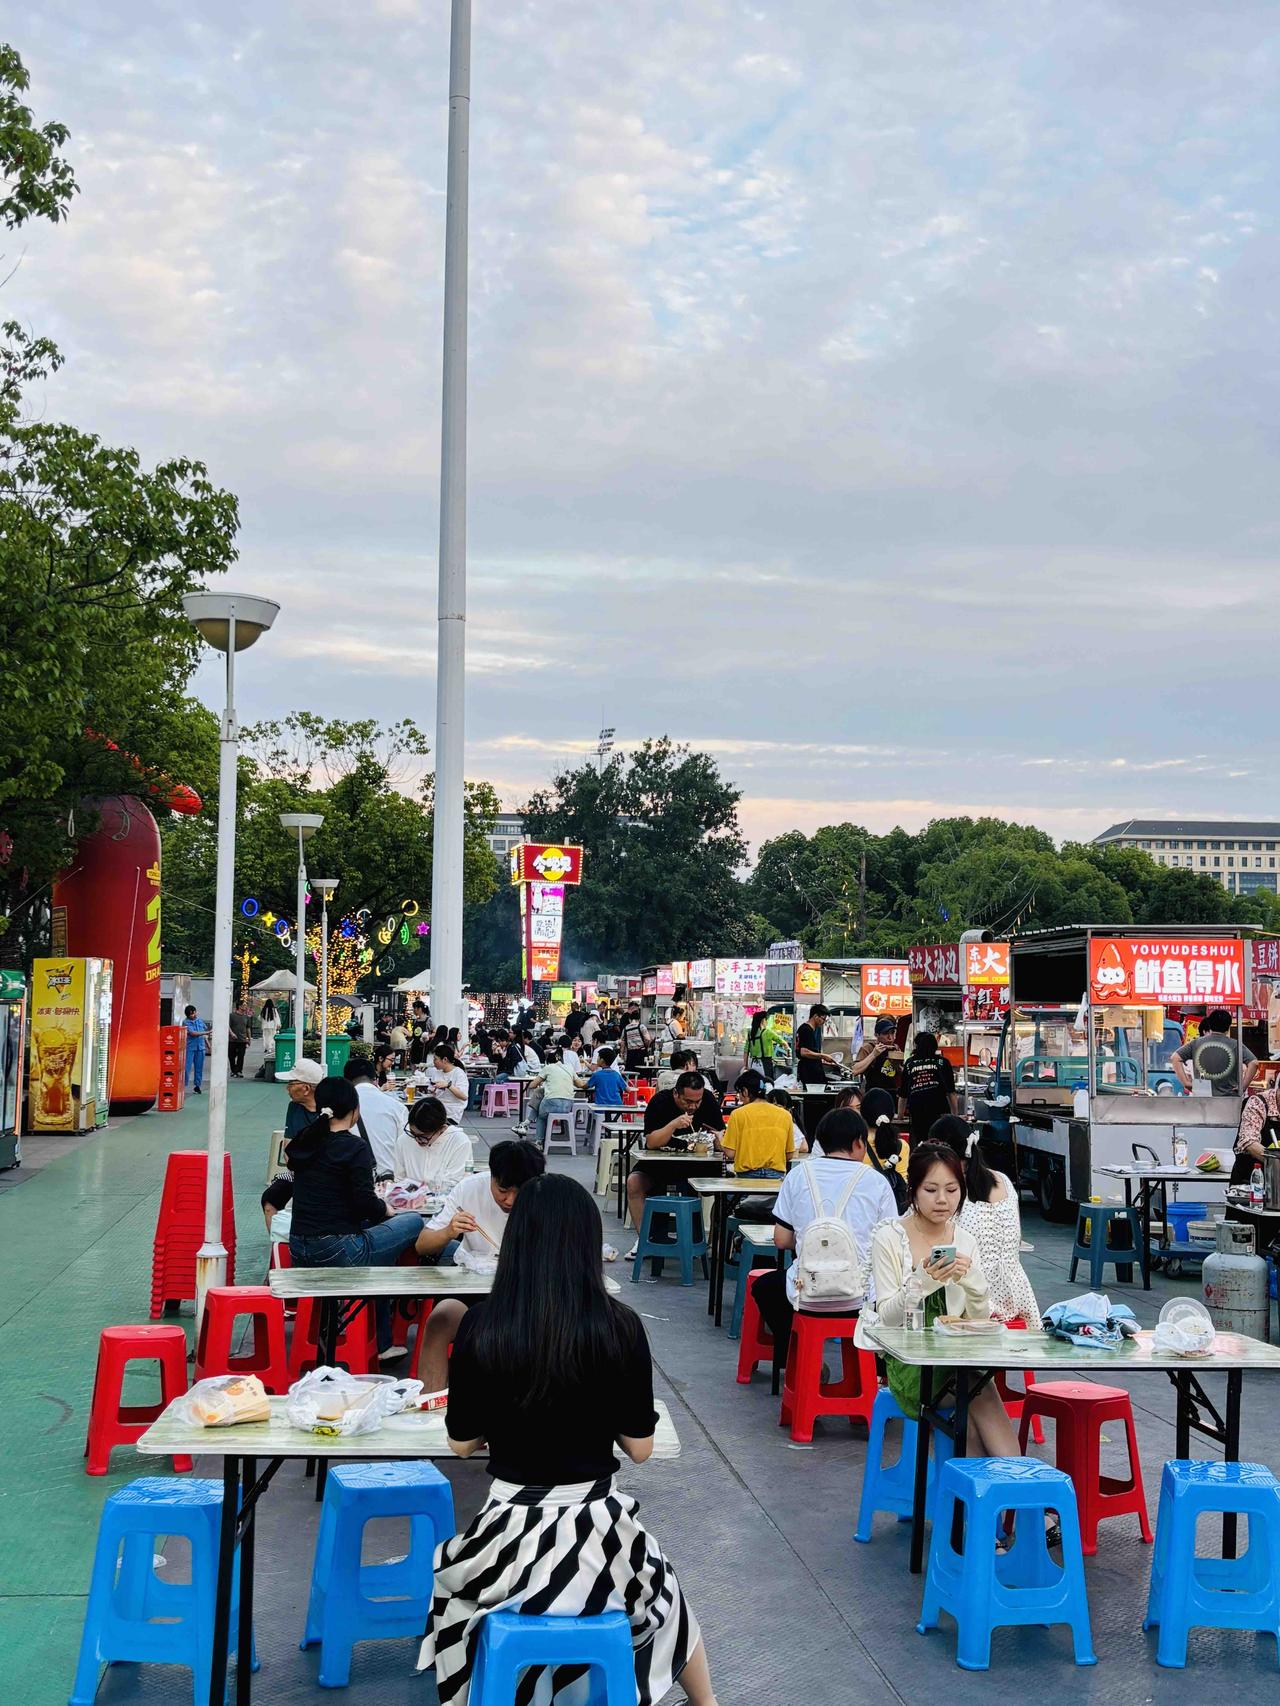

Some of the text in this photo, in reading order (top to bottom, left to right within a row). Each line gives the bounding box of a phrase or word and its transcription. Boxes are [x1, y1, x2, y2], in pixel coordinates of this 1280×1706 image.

[982, 946, 1010, 974] 大
[1131, 945, 1234, 956] YOUYUDESHUI
[1134, 959, 1241, 995] 鱿鱼得水
